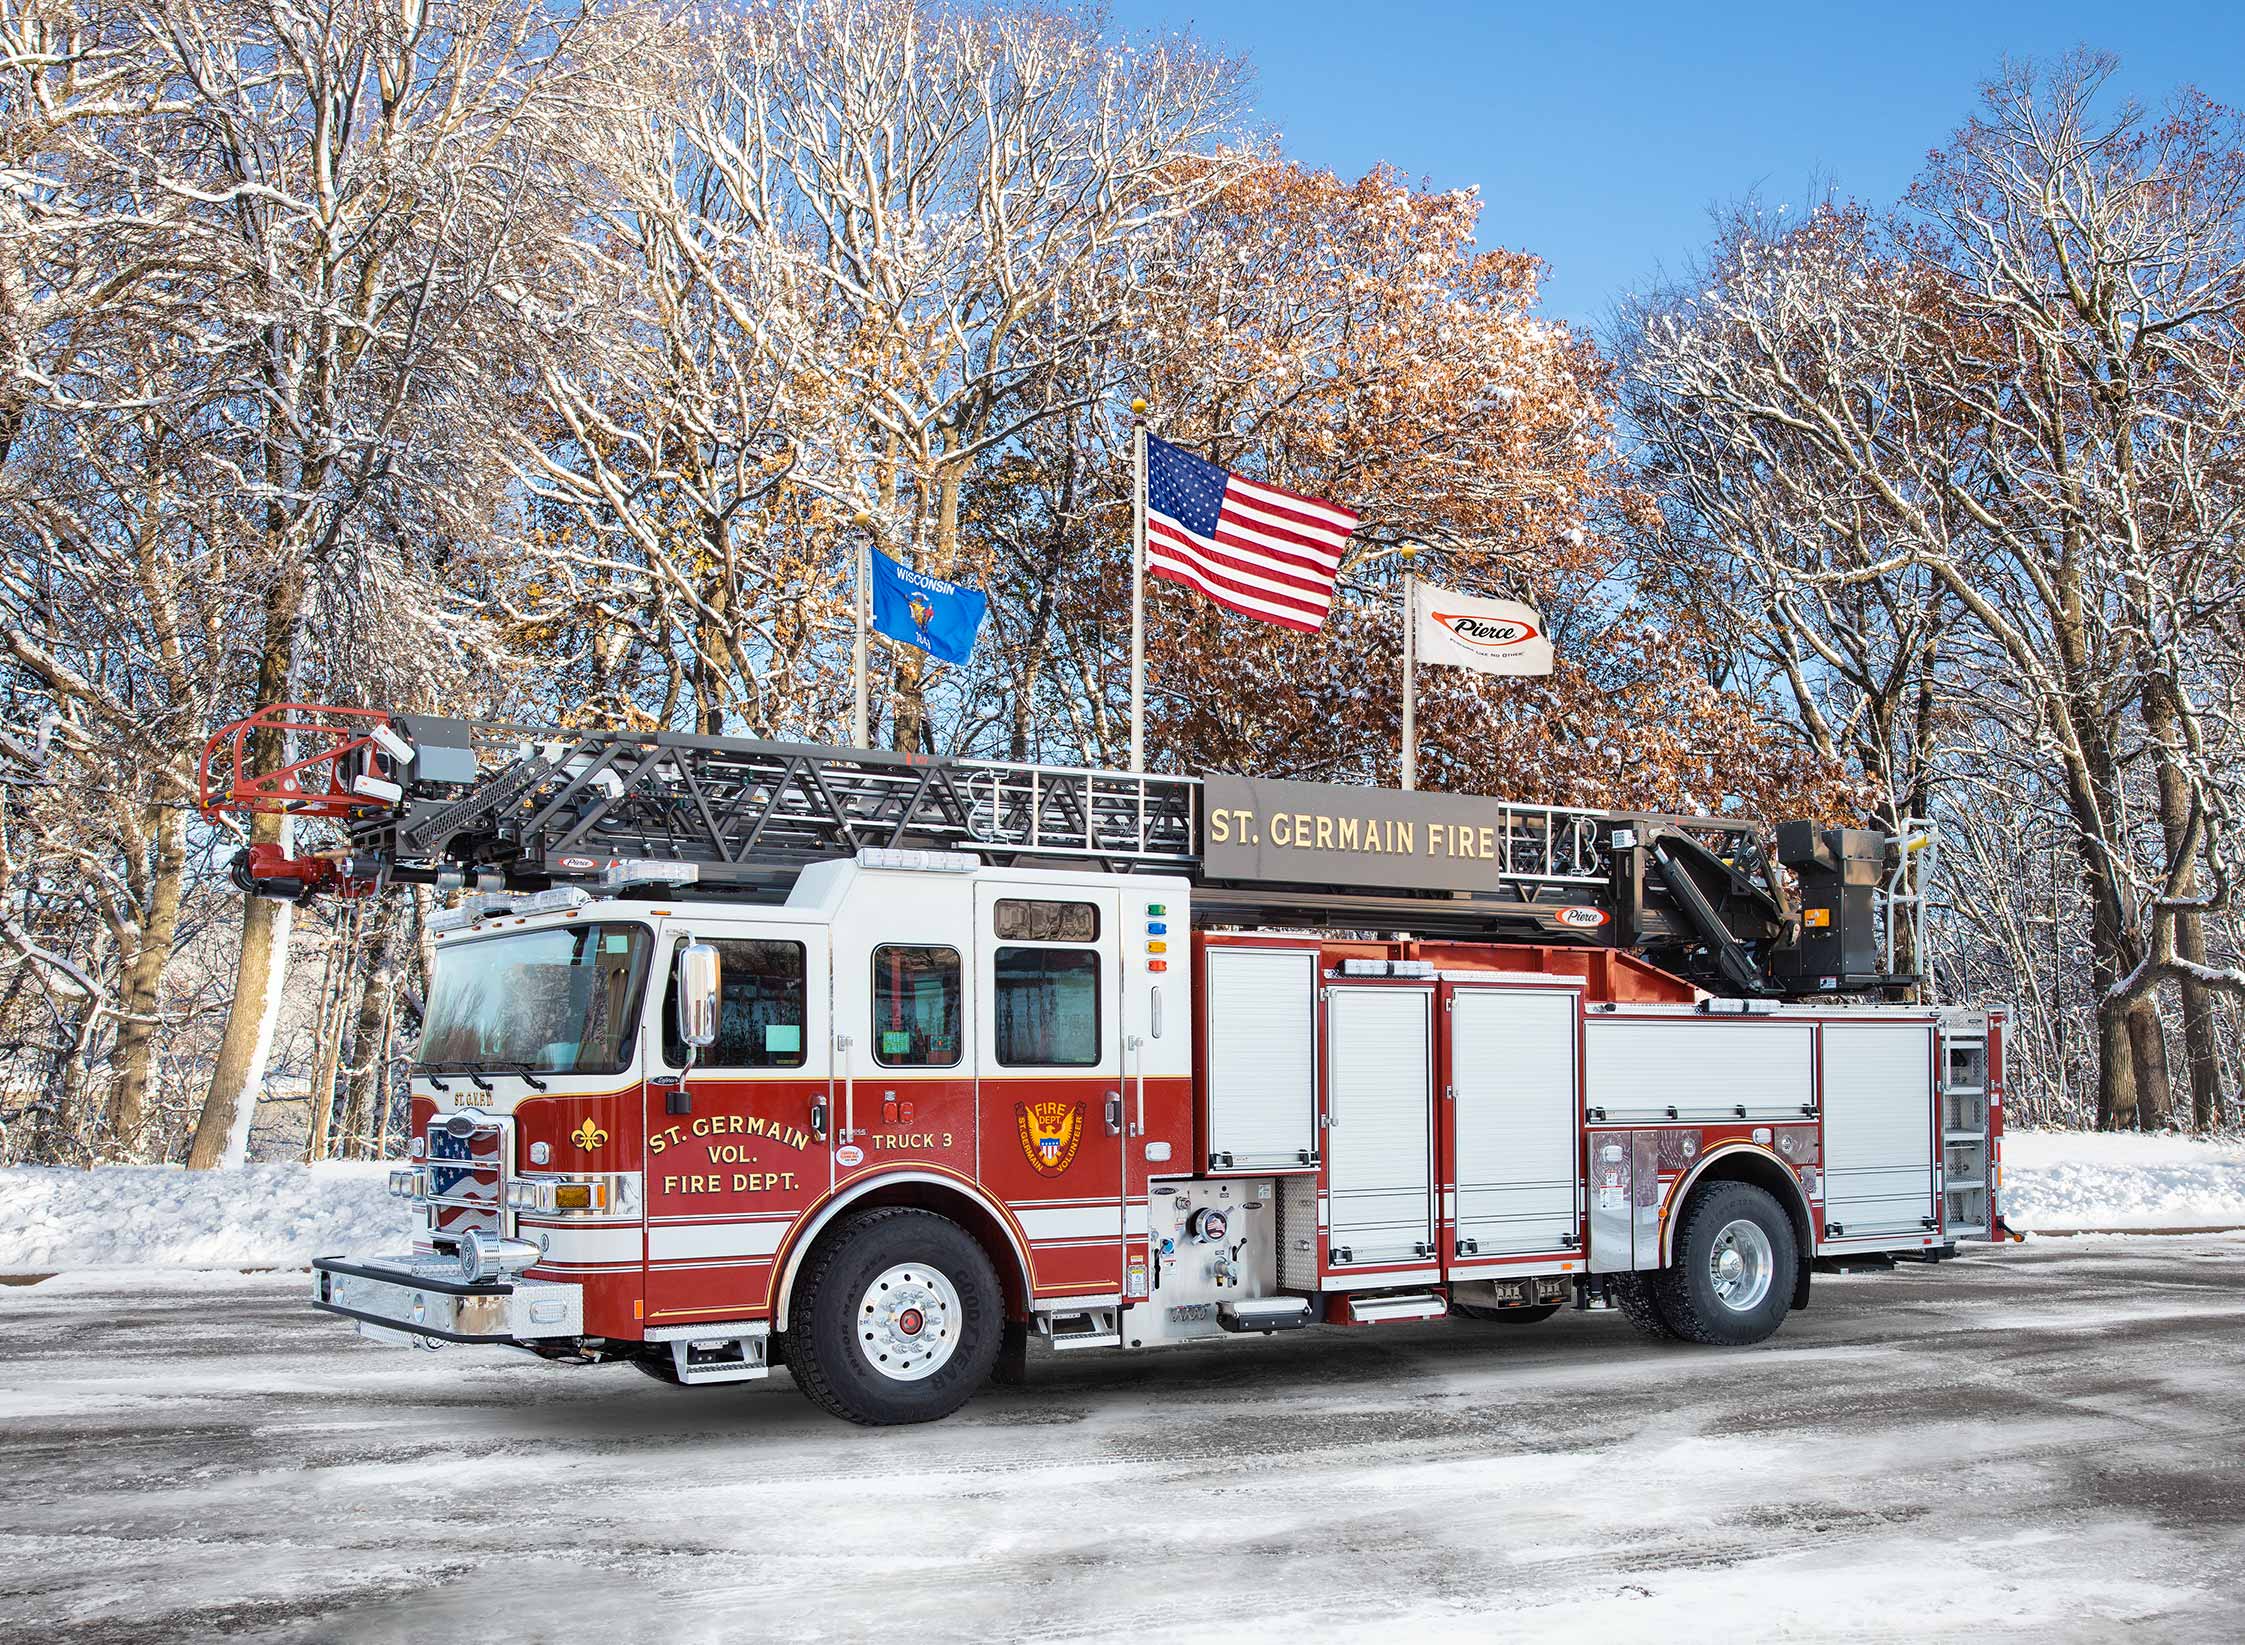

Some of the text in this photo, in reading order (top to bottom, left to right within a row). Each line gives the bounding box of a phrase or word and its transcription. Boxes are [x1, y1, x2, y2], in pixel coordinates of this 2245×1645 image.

[896, 566, 956, 596] WISCONSIN
[1454, 618, 1516, 640] Pierce
[1210, 807, 1495, 859] ST. GERMAIN FIRE
[1567, 909, 1598, 922] Pierce
[1034, 1102, 1067, 1117] FIRE
[1039, 1115, 1062, 1125] DEPT.
[649, 1115, 810, 1155] ST. GERMAIN
[871, 1132, 953, 1150] TRUCK 3
[1056, 1115, 1083, 1172] VOLUNTEER
[706, 1145, 758, 1165] VOL.
[662, 1172, 801, 1195] FIRE DEPT.
